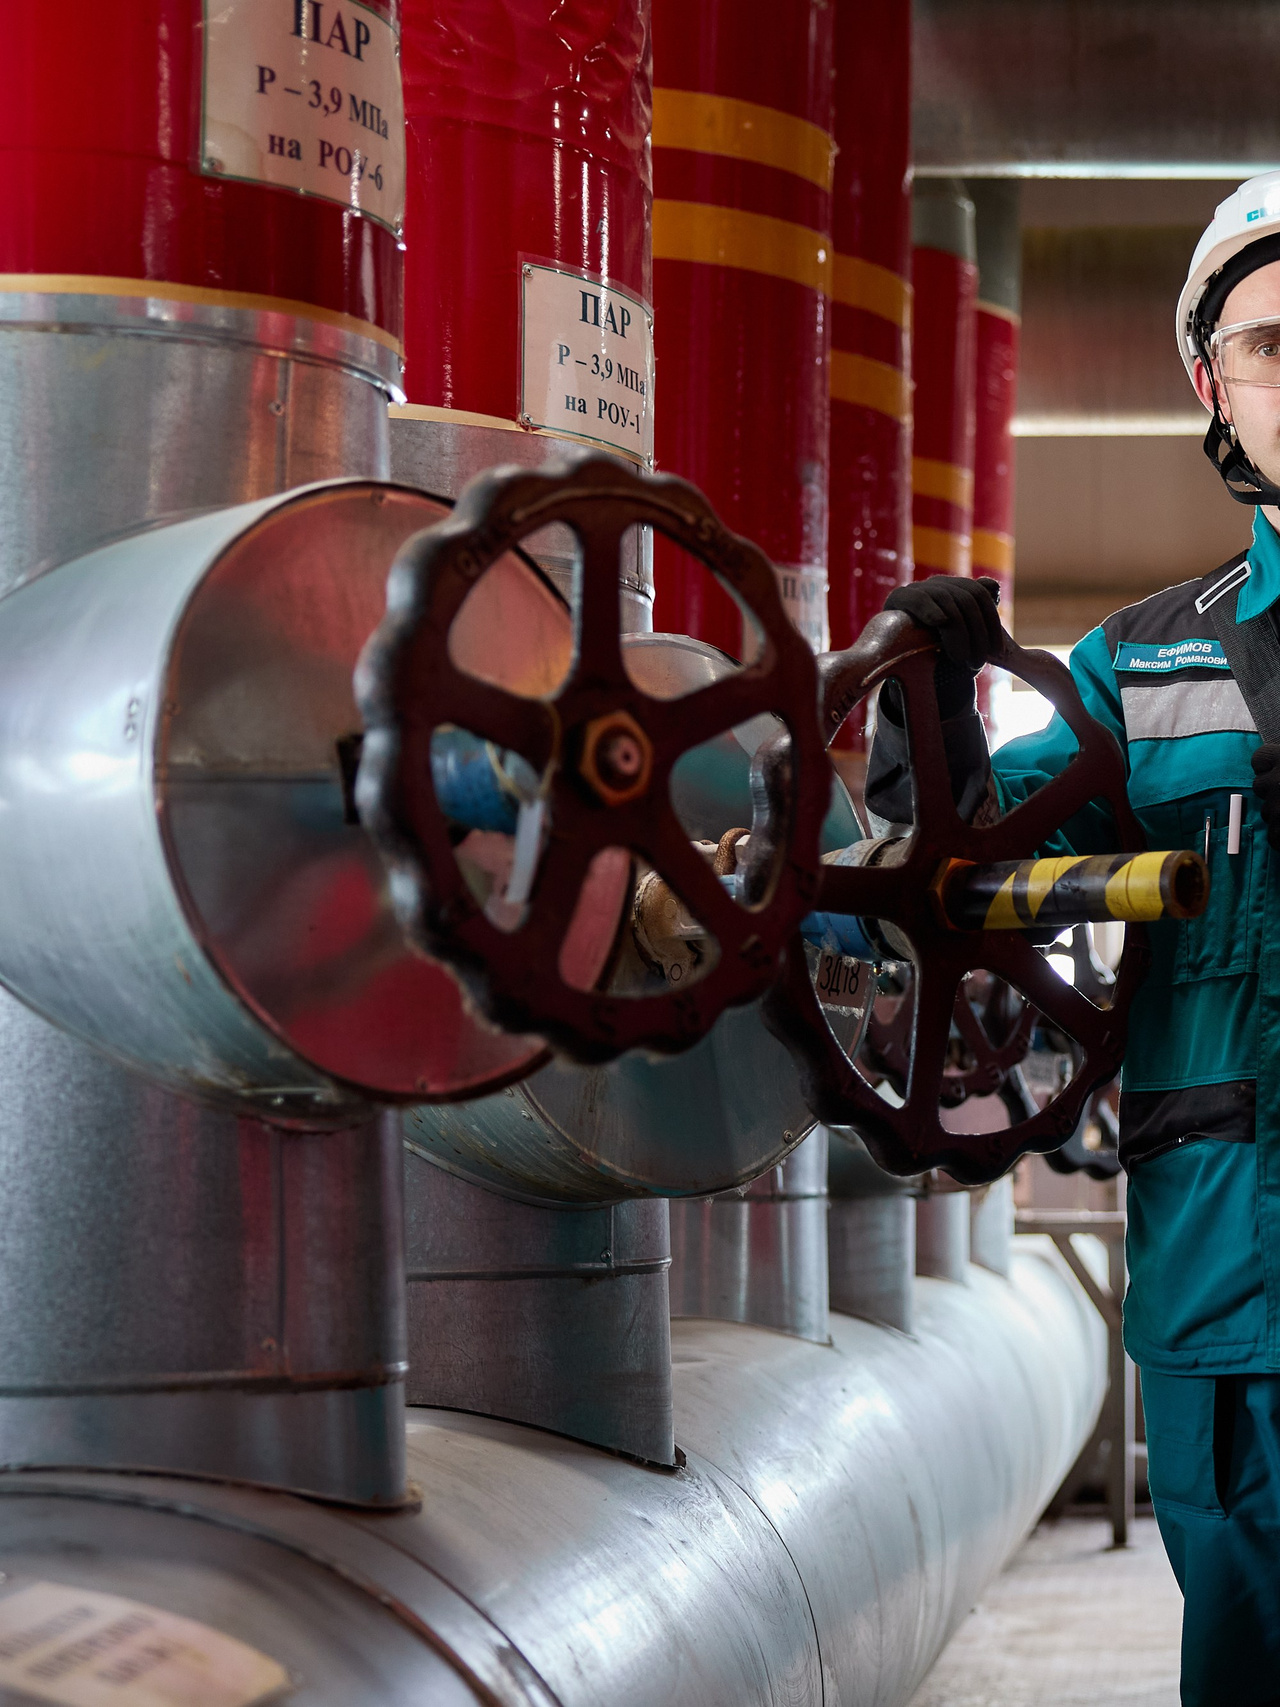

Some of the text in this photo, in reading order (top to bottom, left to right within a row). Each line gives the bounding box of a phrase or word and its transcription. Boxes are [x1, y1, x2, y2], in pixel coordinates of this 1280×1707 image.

[289, 0, 371, 62] ПАР
[308, 79, 343, 118] 3,9
[348, 92, 389, 140] МПа
[268, 134, 384, 191] на РОУ-6
[579, 289, 631, 339] ПАР
[591, 353, 613, 381] 3,9
[616, 362, 646, 396] МПа
[564, 394, 641, 435] на РОУ-1
[1129, 655, 1228, 668] Максим Романови
[1158, 643, 1212, 657] ЕФИМОВ
